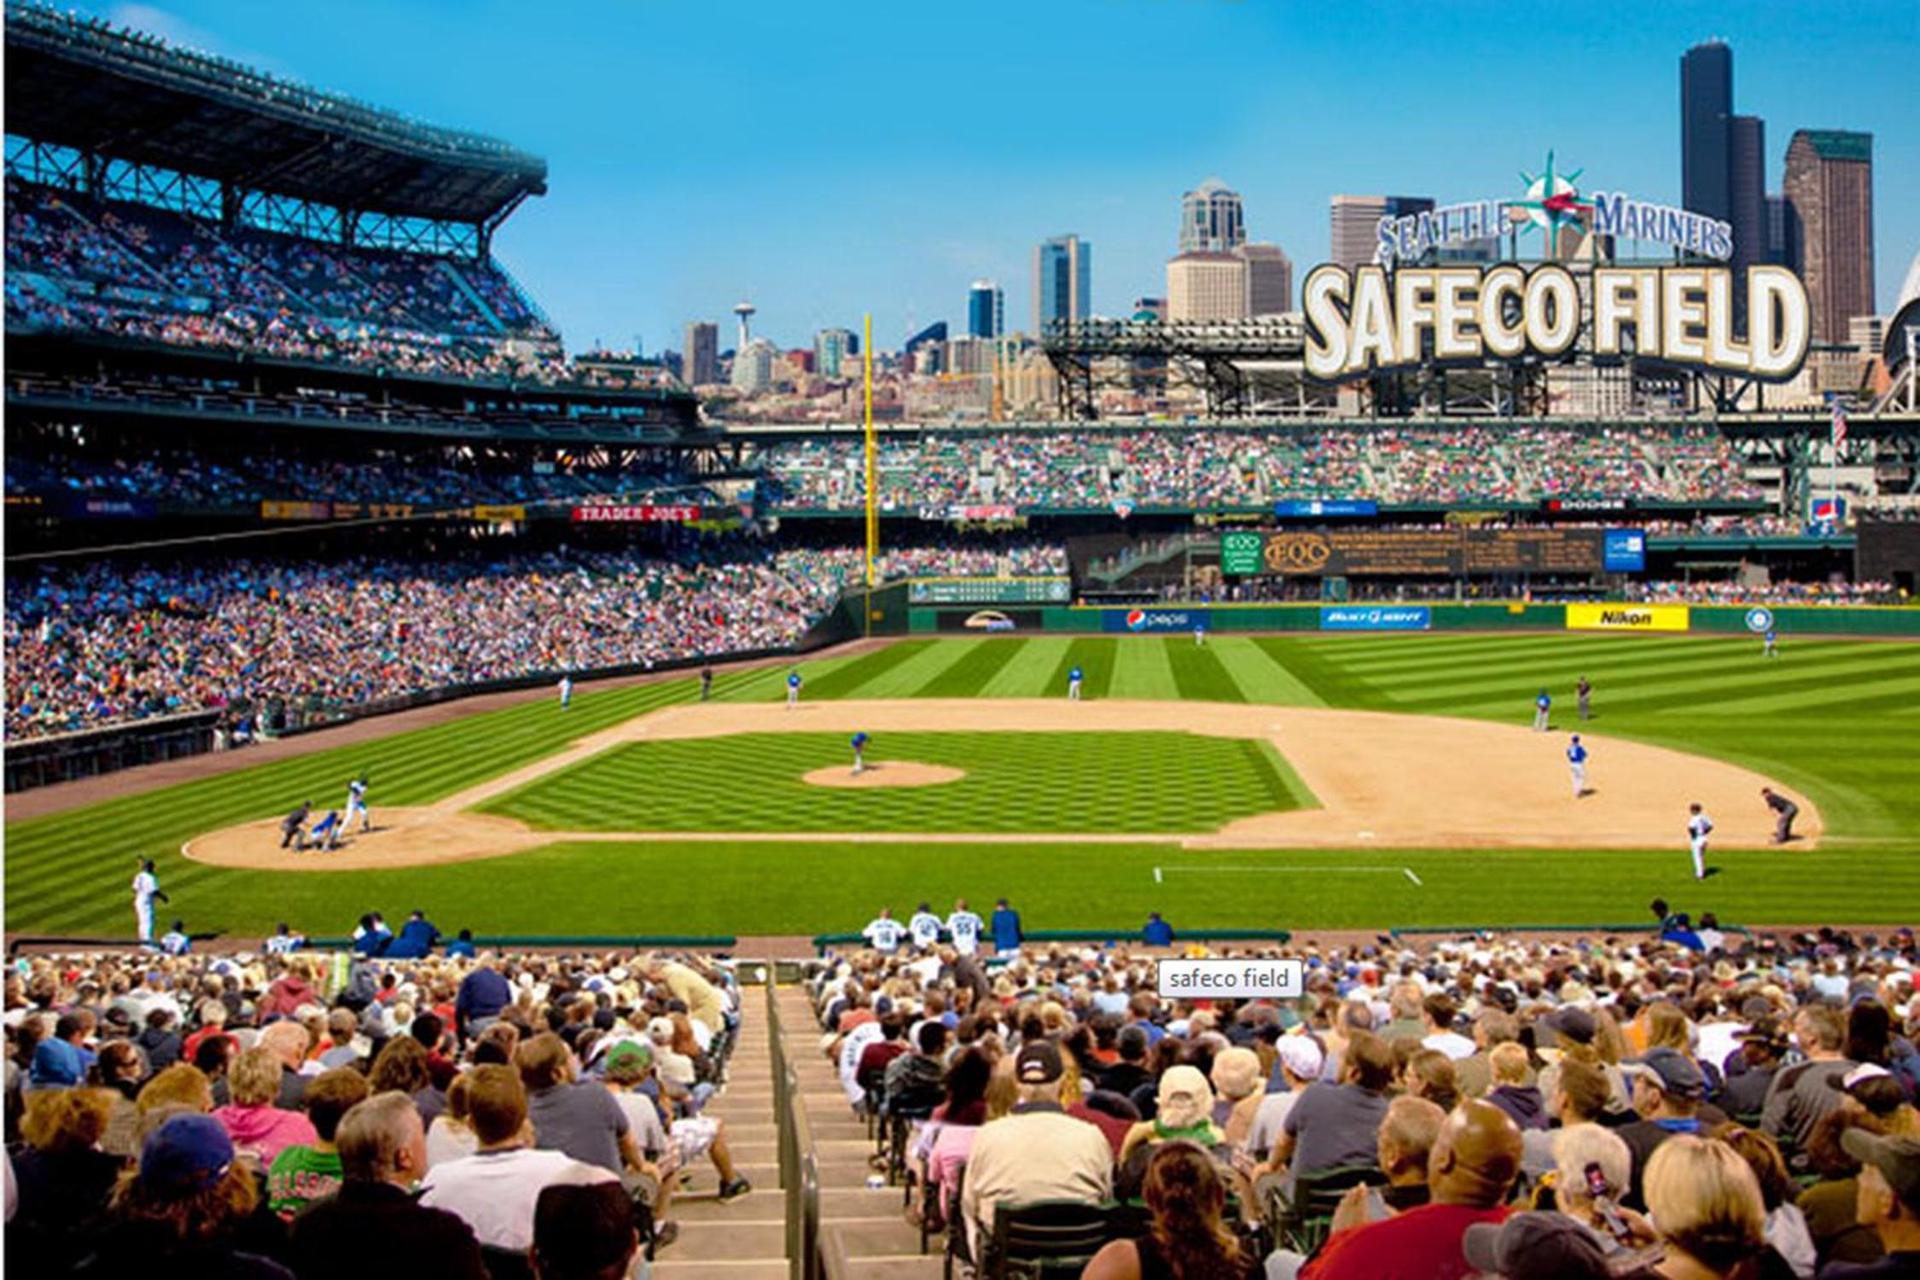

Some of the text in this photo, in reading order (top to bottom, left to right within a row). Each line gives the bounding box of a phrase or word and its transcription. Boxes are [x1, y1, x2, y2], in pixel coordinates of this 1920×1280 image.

[1375, 192, 1733, 260] SEATTLE MARINERS
[1304, 263, 1810, 382] SAFECO FIELD
[1561, 500, 1625, 509] DODGE
[580, 506, 693, 521] TRADER JOE'S
[1147, 612, 1189, 627] pepsi
[1600, 610, 1652, 625] Nikon
